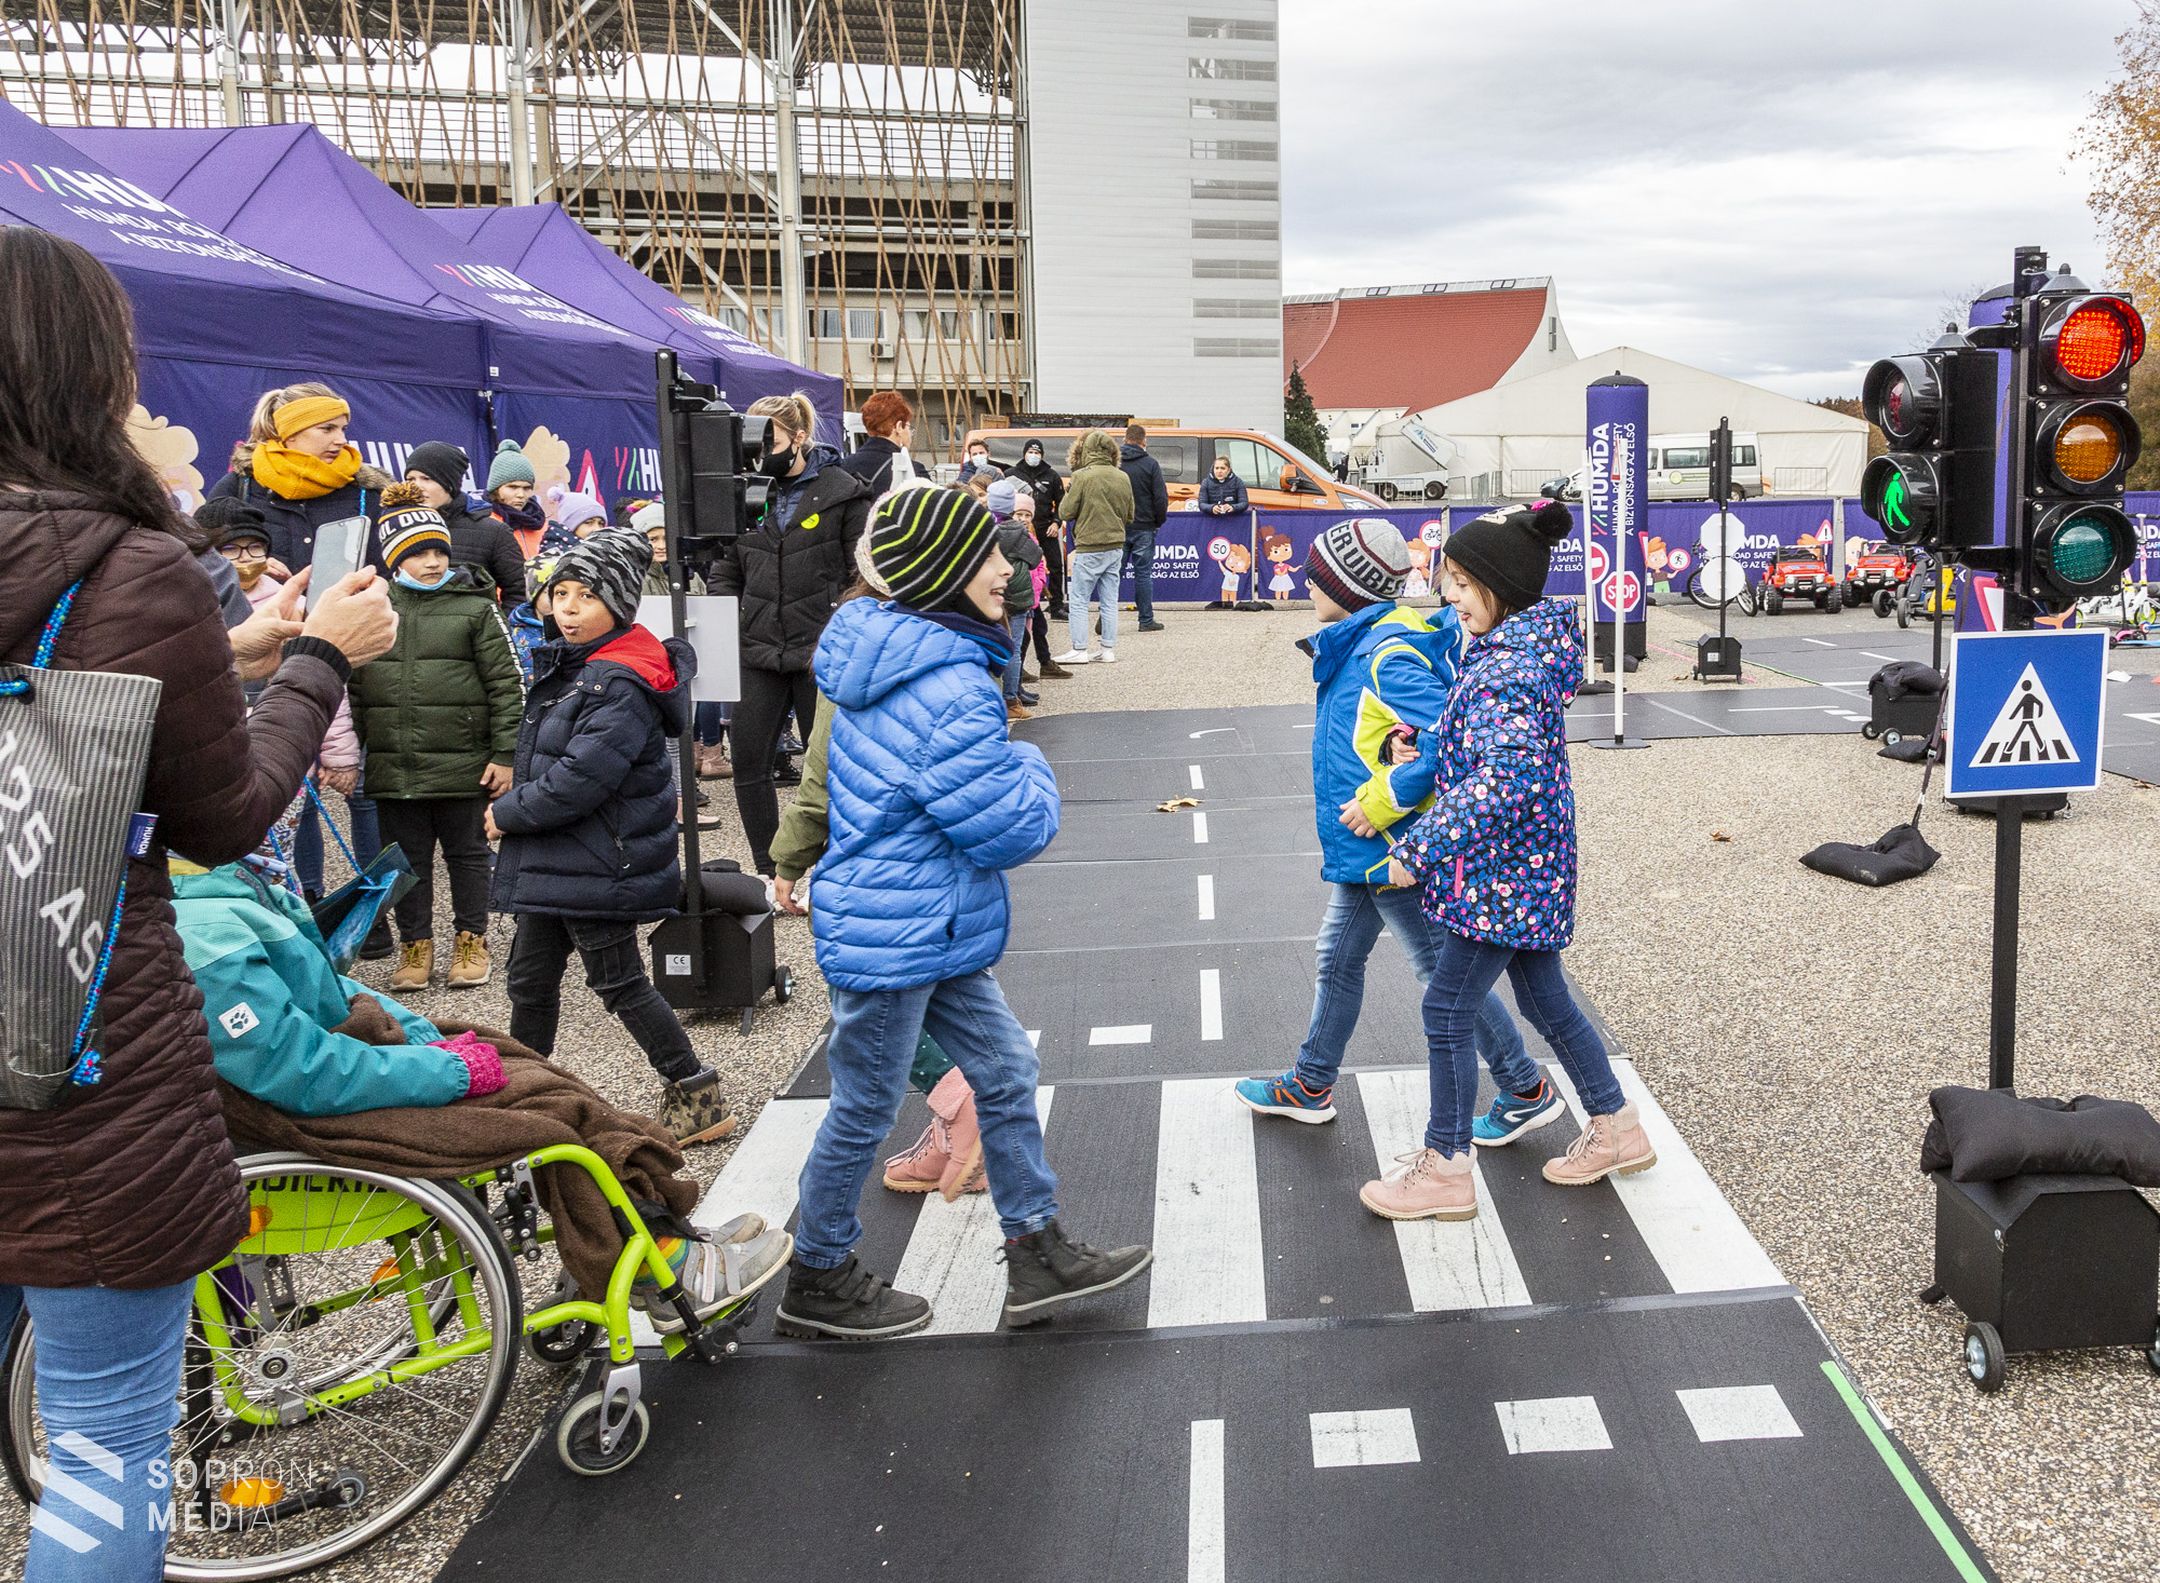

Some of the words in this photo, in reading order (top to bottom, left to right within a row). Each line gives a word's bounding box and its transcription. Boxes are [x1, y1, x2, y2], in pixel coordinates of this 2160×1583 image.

[61, 203, 173, 234] HUMDA
[1627, 451, 1635, 466] AZ
[1593, 423, 1609, 511] HUMDA
[1213, 544, 1227, 555] 50
[1152, 562, 1170, 570] OAD
[1173, 562, 1199, 570] SAFETY
[1564, 563, 1583, 572] ELSŐ
[1607, 585, 1637, 600] SOP
[673, 956, 686, 965] CE
